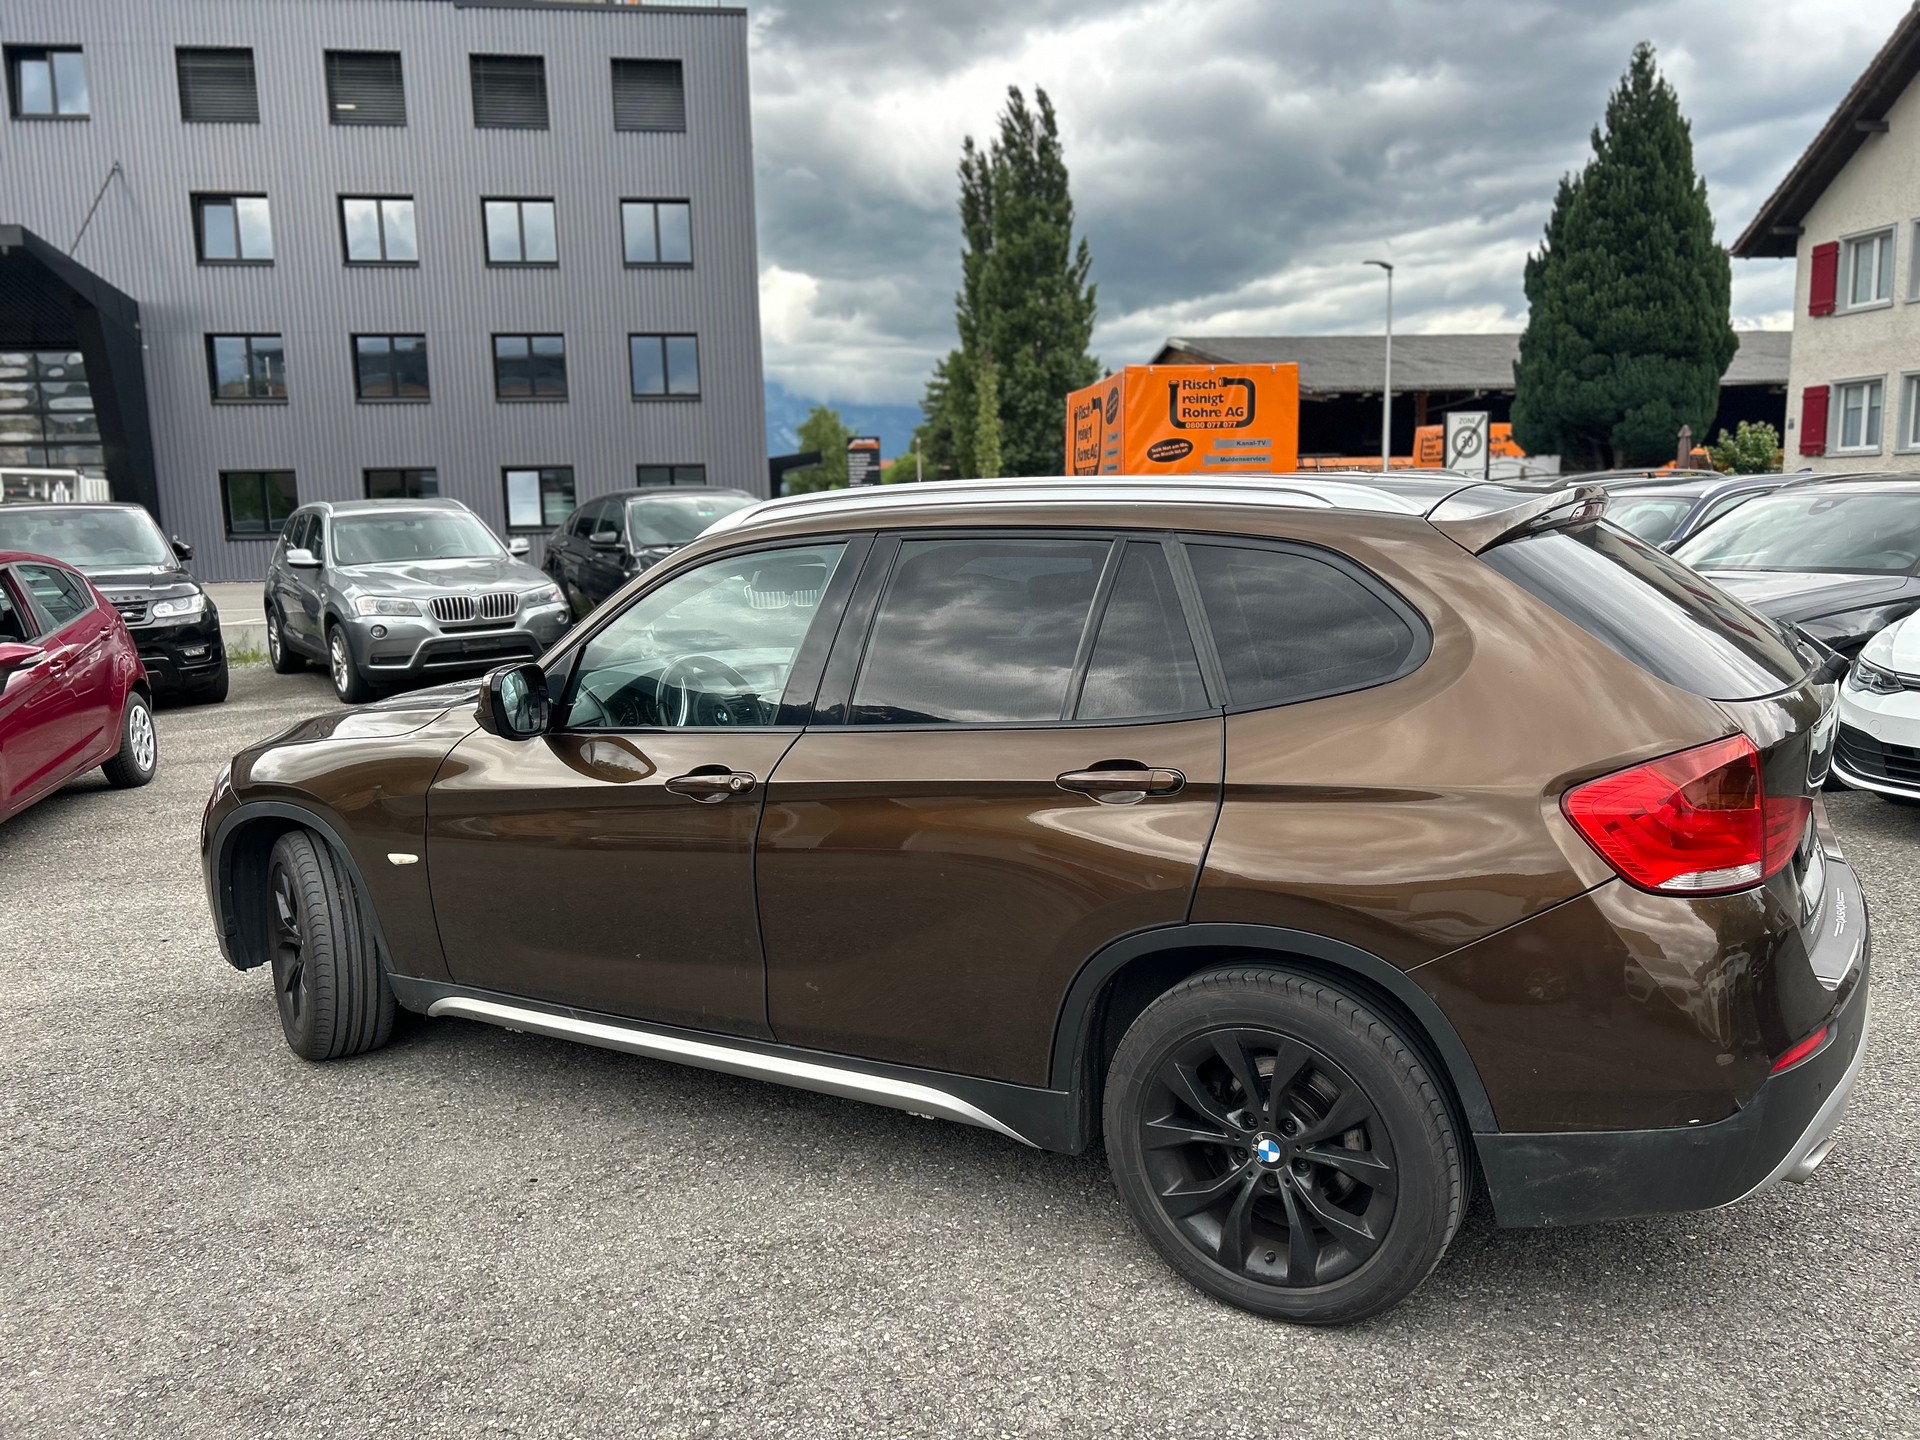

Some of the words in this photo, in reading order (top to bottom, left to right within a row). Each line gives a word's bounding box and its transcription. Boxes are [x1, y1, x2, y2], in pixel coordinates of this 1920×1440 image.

[1182, 379, 1216, 390] Risch
[1182, 393, 1224, 406] reinigt
[1182, 407, 1222, 418] Rohre
[1225, 406, 1244, 417] AG
[1185, 421, 1205, 429] 0800
[1461, 436, 1473, 448] 30
